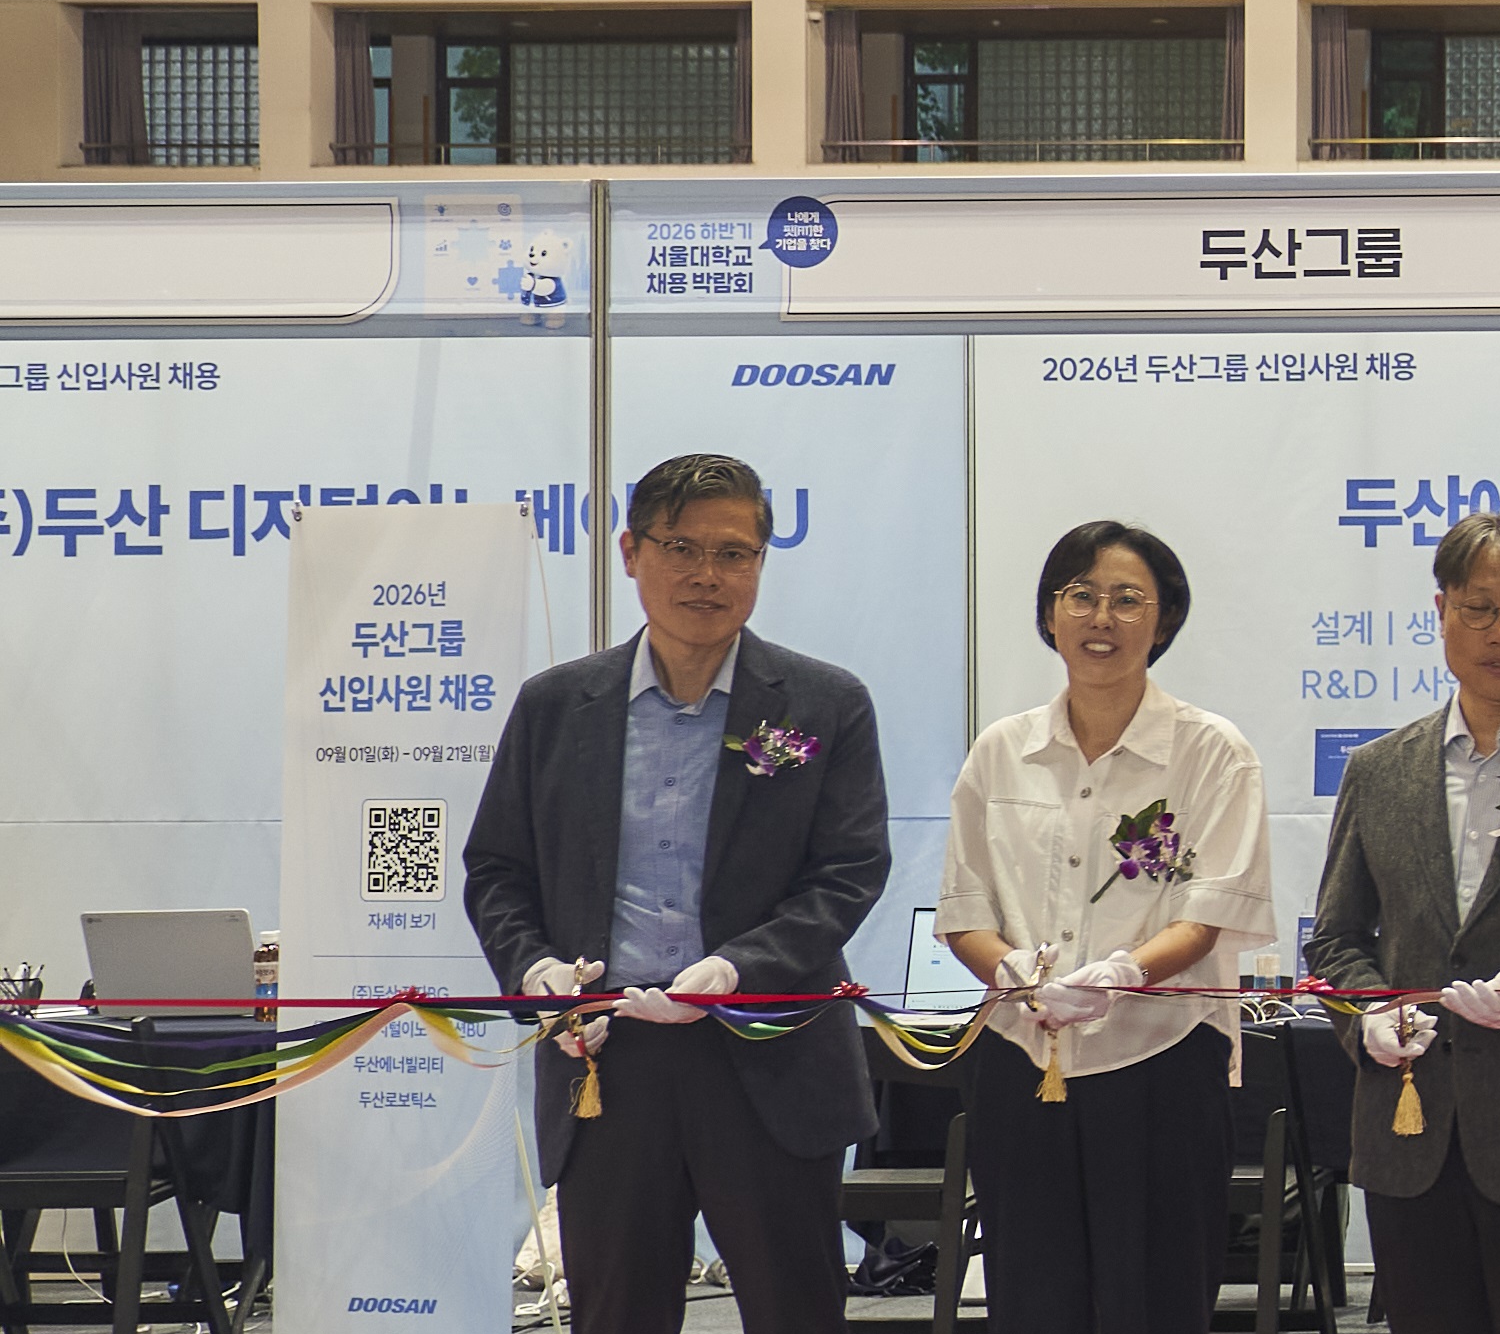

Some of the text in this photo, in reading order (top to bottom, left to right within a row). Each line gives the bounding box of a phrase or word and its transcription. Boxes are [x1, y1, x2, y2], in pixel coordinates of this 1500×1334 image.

[648, 223, 752, 240] 2026 하반기
[648, 246, 752, 267] 서울대학교
[1200, 229, 1402, 280] 두산그룹
[647, 272, 752, 294] 채용 박람회
[57, 362, 220, 390] 신입사원 채용
[732, 364, 896, 386] DOOSAN
[1043, 353, 1416, 382] 2026년 두산그룹 신입사원 채용
[373, 581, 445, 606] 2026년
[352, 620, 465, 658] 두산그룹
[1312, 611, 1372, 645] 설계
[319, 674, 495, 712] 신입사원 채용
[1303, 670, 1377, 699] R&D
[316, 746, 346, 763] 09월
[349, 746, 399, 762] 01일(화)
[413, 746, 443, 762] 09월
[368, 913, 435, 929] 자세히 보기
[354, 1056, 443, 1073] 두산에너빌리티
[359, 1092, 436, 1108] 두산로보틱스
[348, 1298, 437, 1314] DOOSAN
